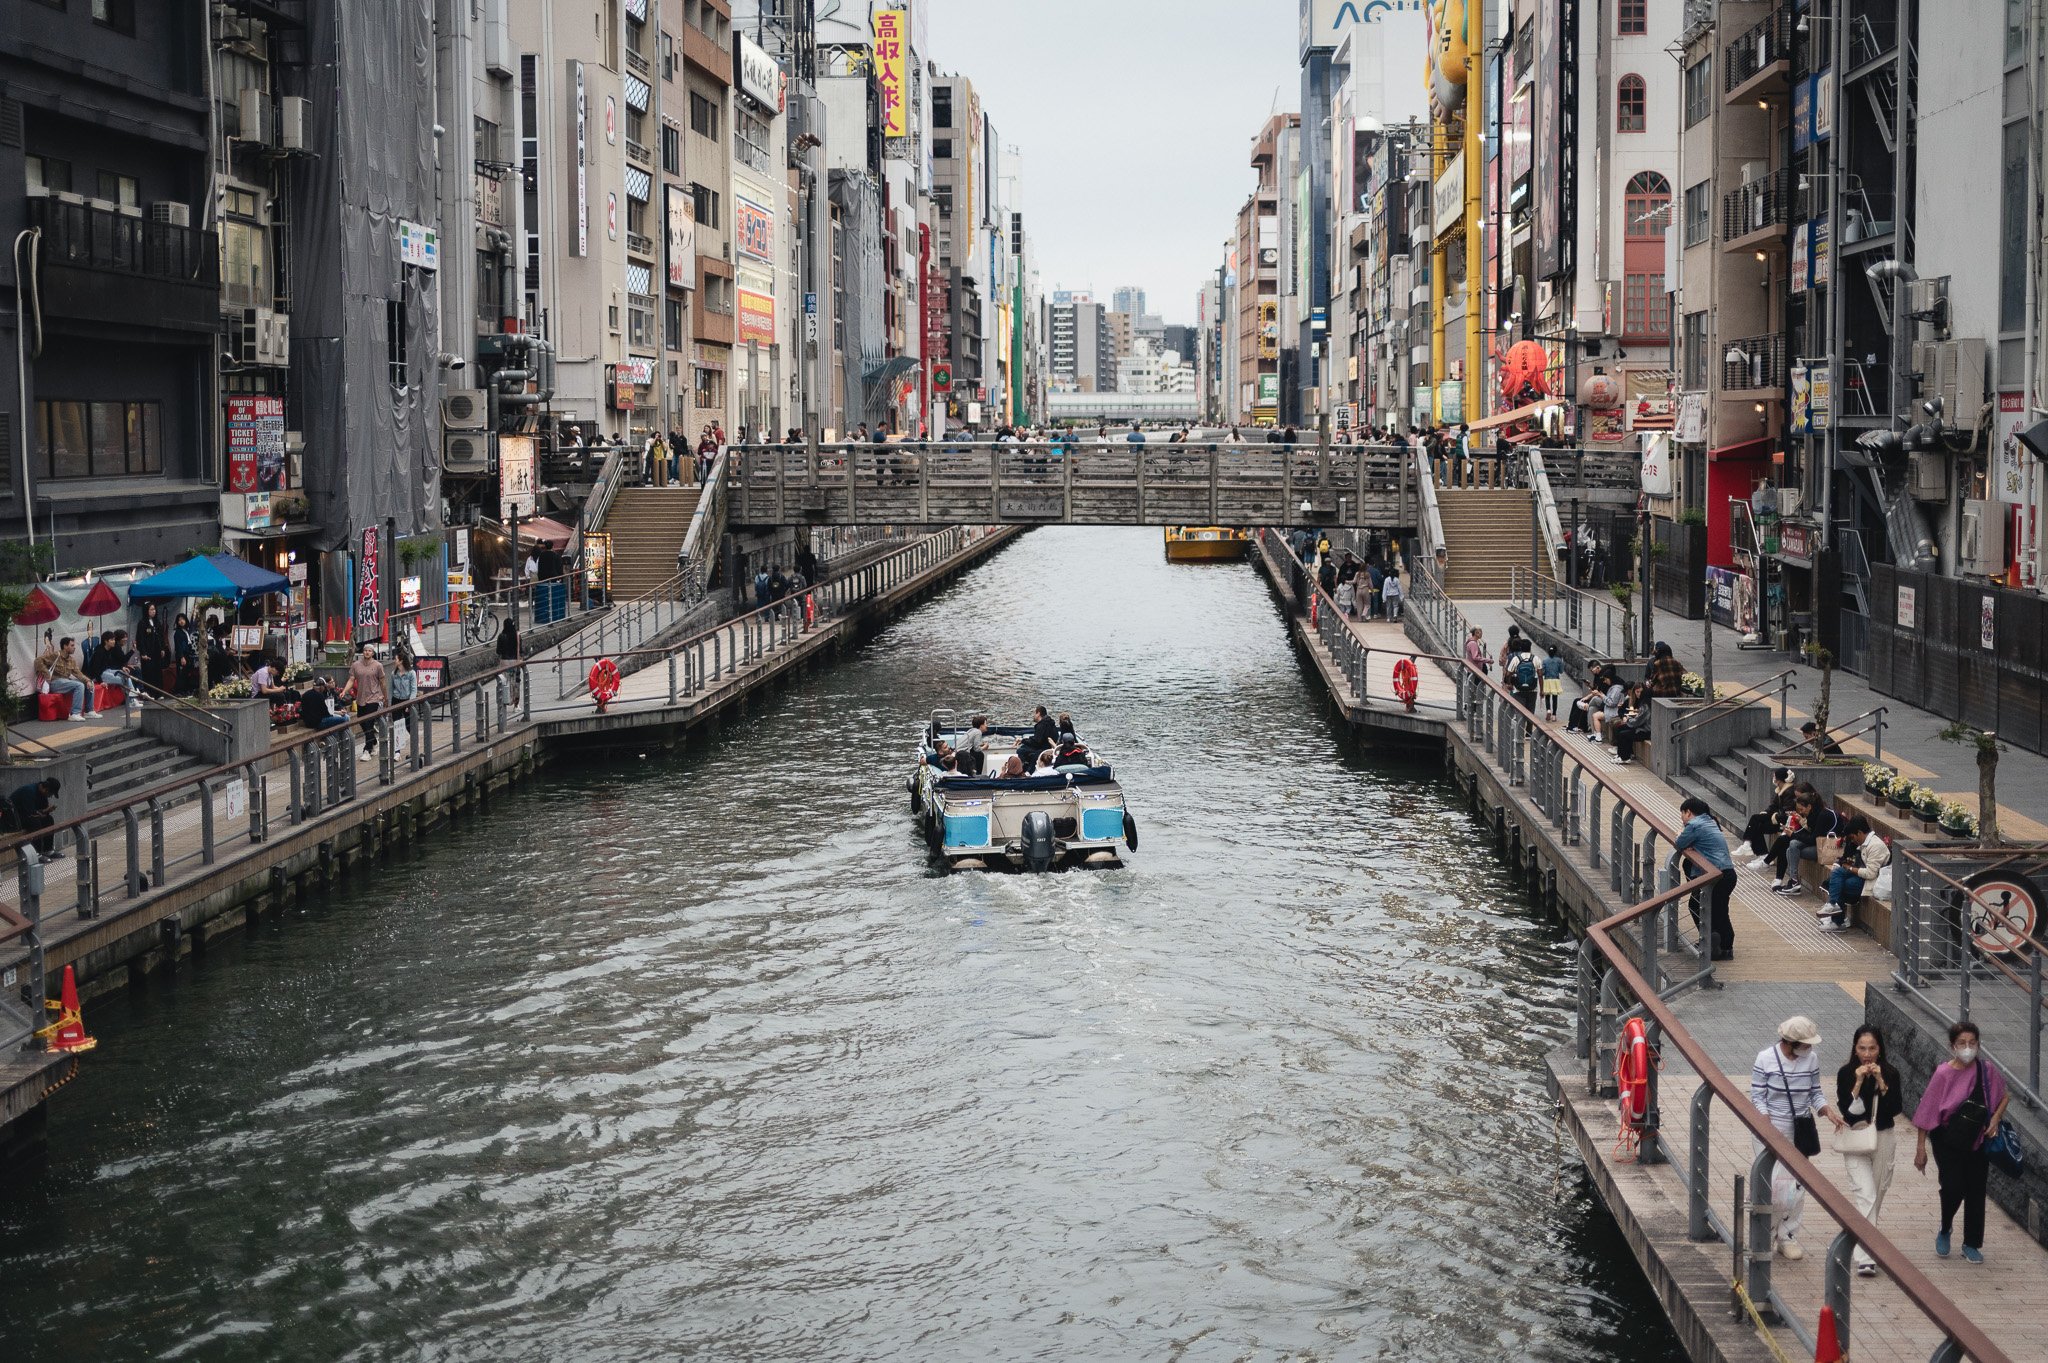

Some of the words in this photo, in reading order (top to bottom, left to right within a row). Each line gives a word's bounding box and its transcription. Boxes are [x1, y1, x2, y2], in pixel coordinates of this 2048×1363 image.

[876, 14, 900, 132] 高収入求人
[747, 211, 766, 252] ダイコク
[807, 294, 816, 312] 焼肉
[231, 429, 254, 437] TICKET
[1337, 408, 1349, 432] 伝串
[359, 558, 377, 626] たこ焼
